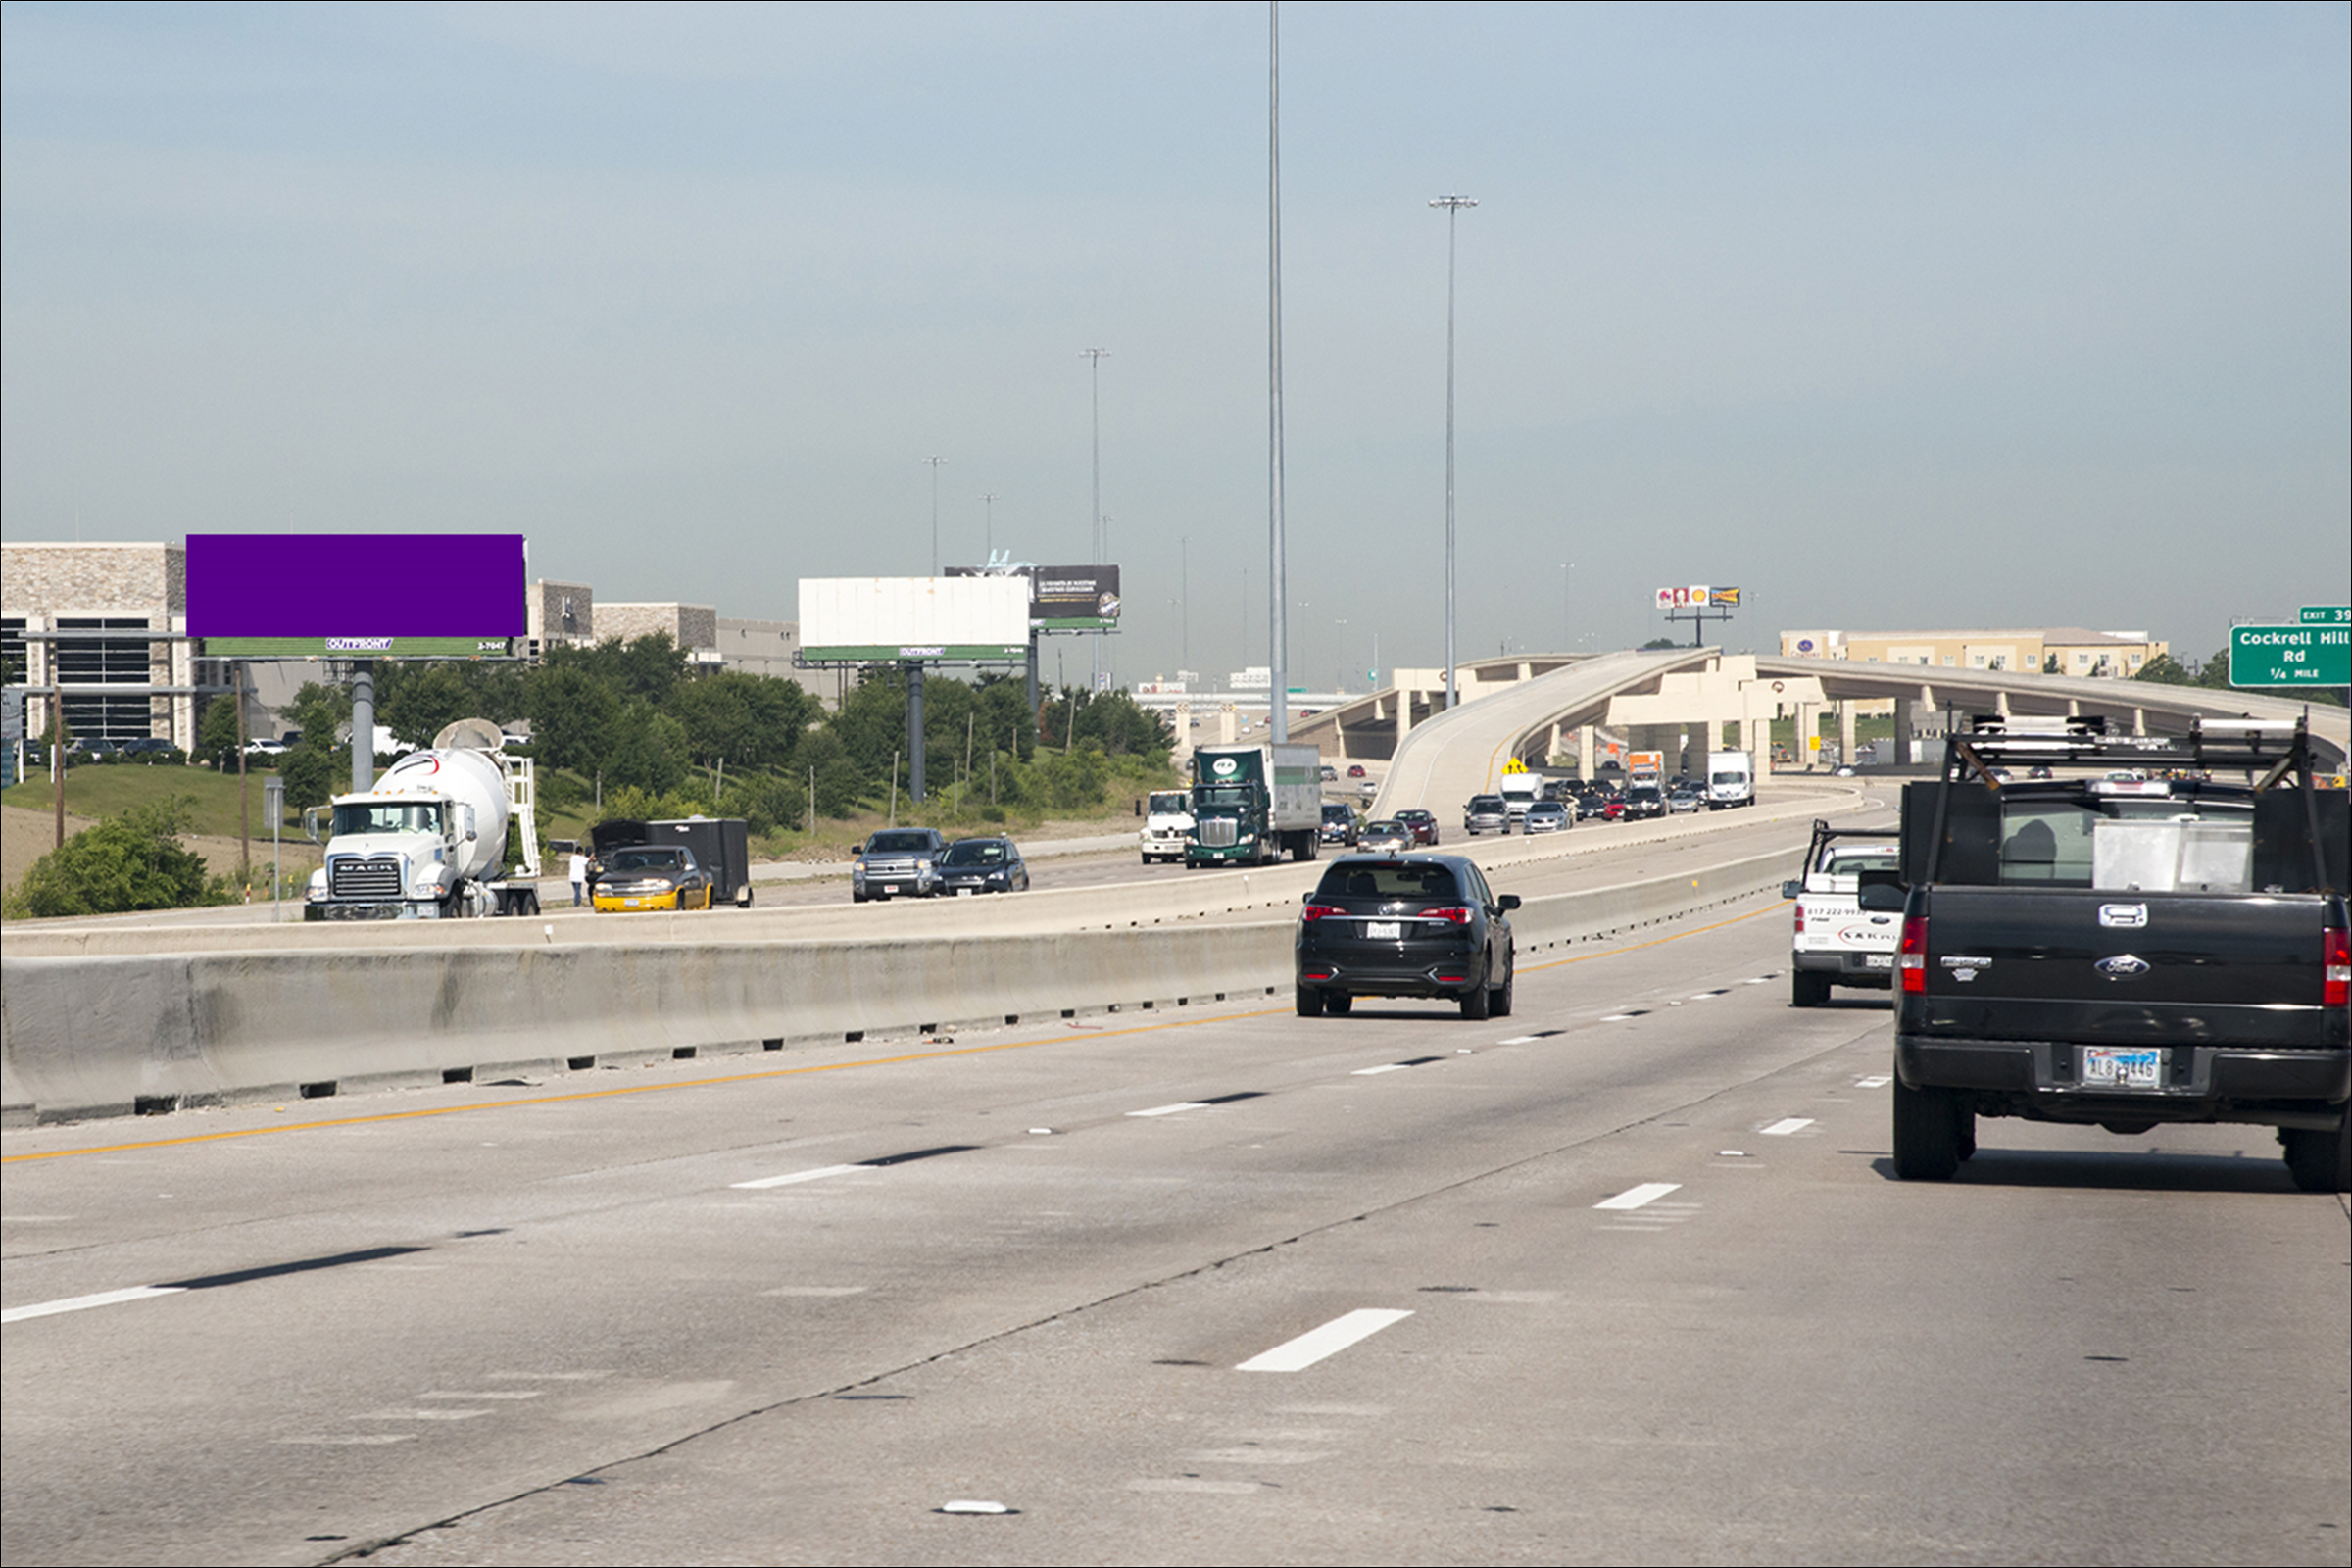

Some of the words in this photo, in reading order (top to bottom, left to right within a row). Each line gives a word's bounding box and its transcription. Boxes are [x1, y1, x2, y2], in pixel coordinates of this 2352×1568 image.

[2303, 611, 2326, 620] EXIT
[326, 638, 393, 650] OUTFRONT
[2239, 631, 2312, 645] Cockrell
[2320, 631, 2350, 645] Hill
[899, 647, 945, 656] OUTFRONT
[2283, 649, 2305, 662] Rd
[2294, 668, 2319, 678] MILE
[2107, 960, 2138, 973] Ford
